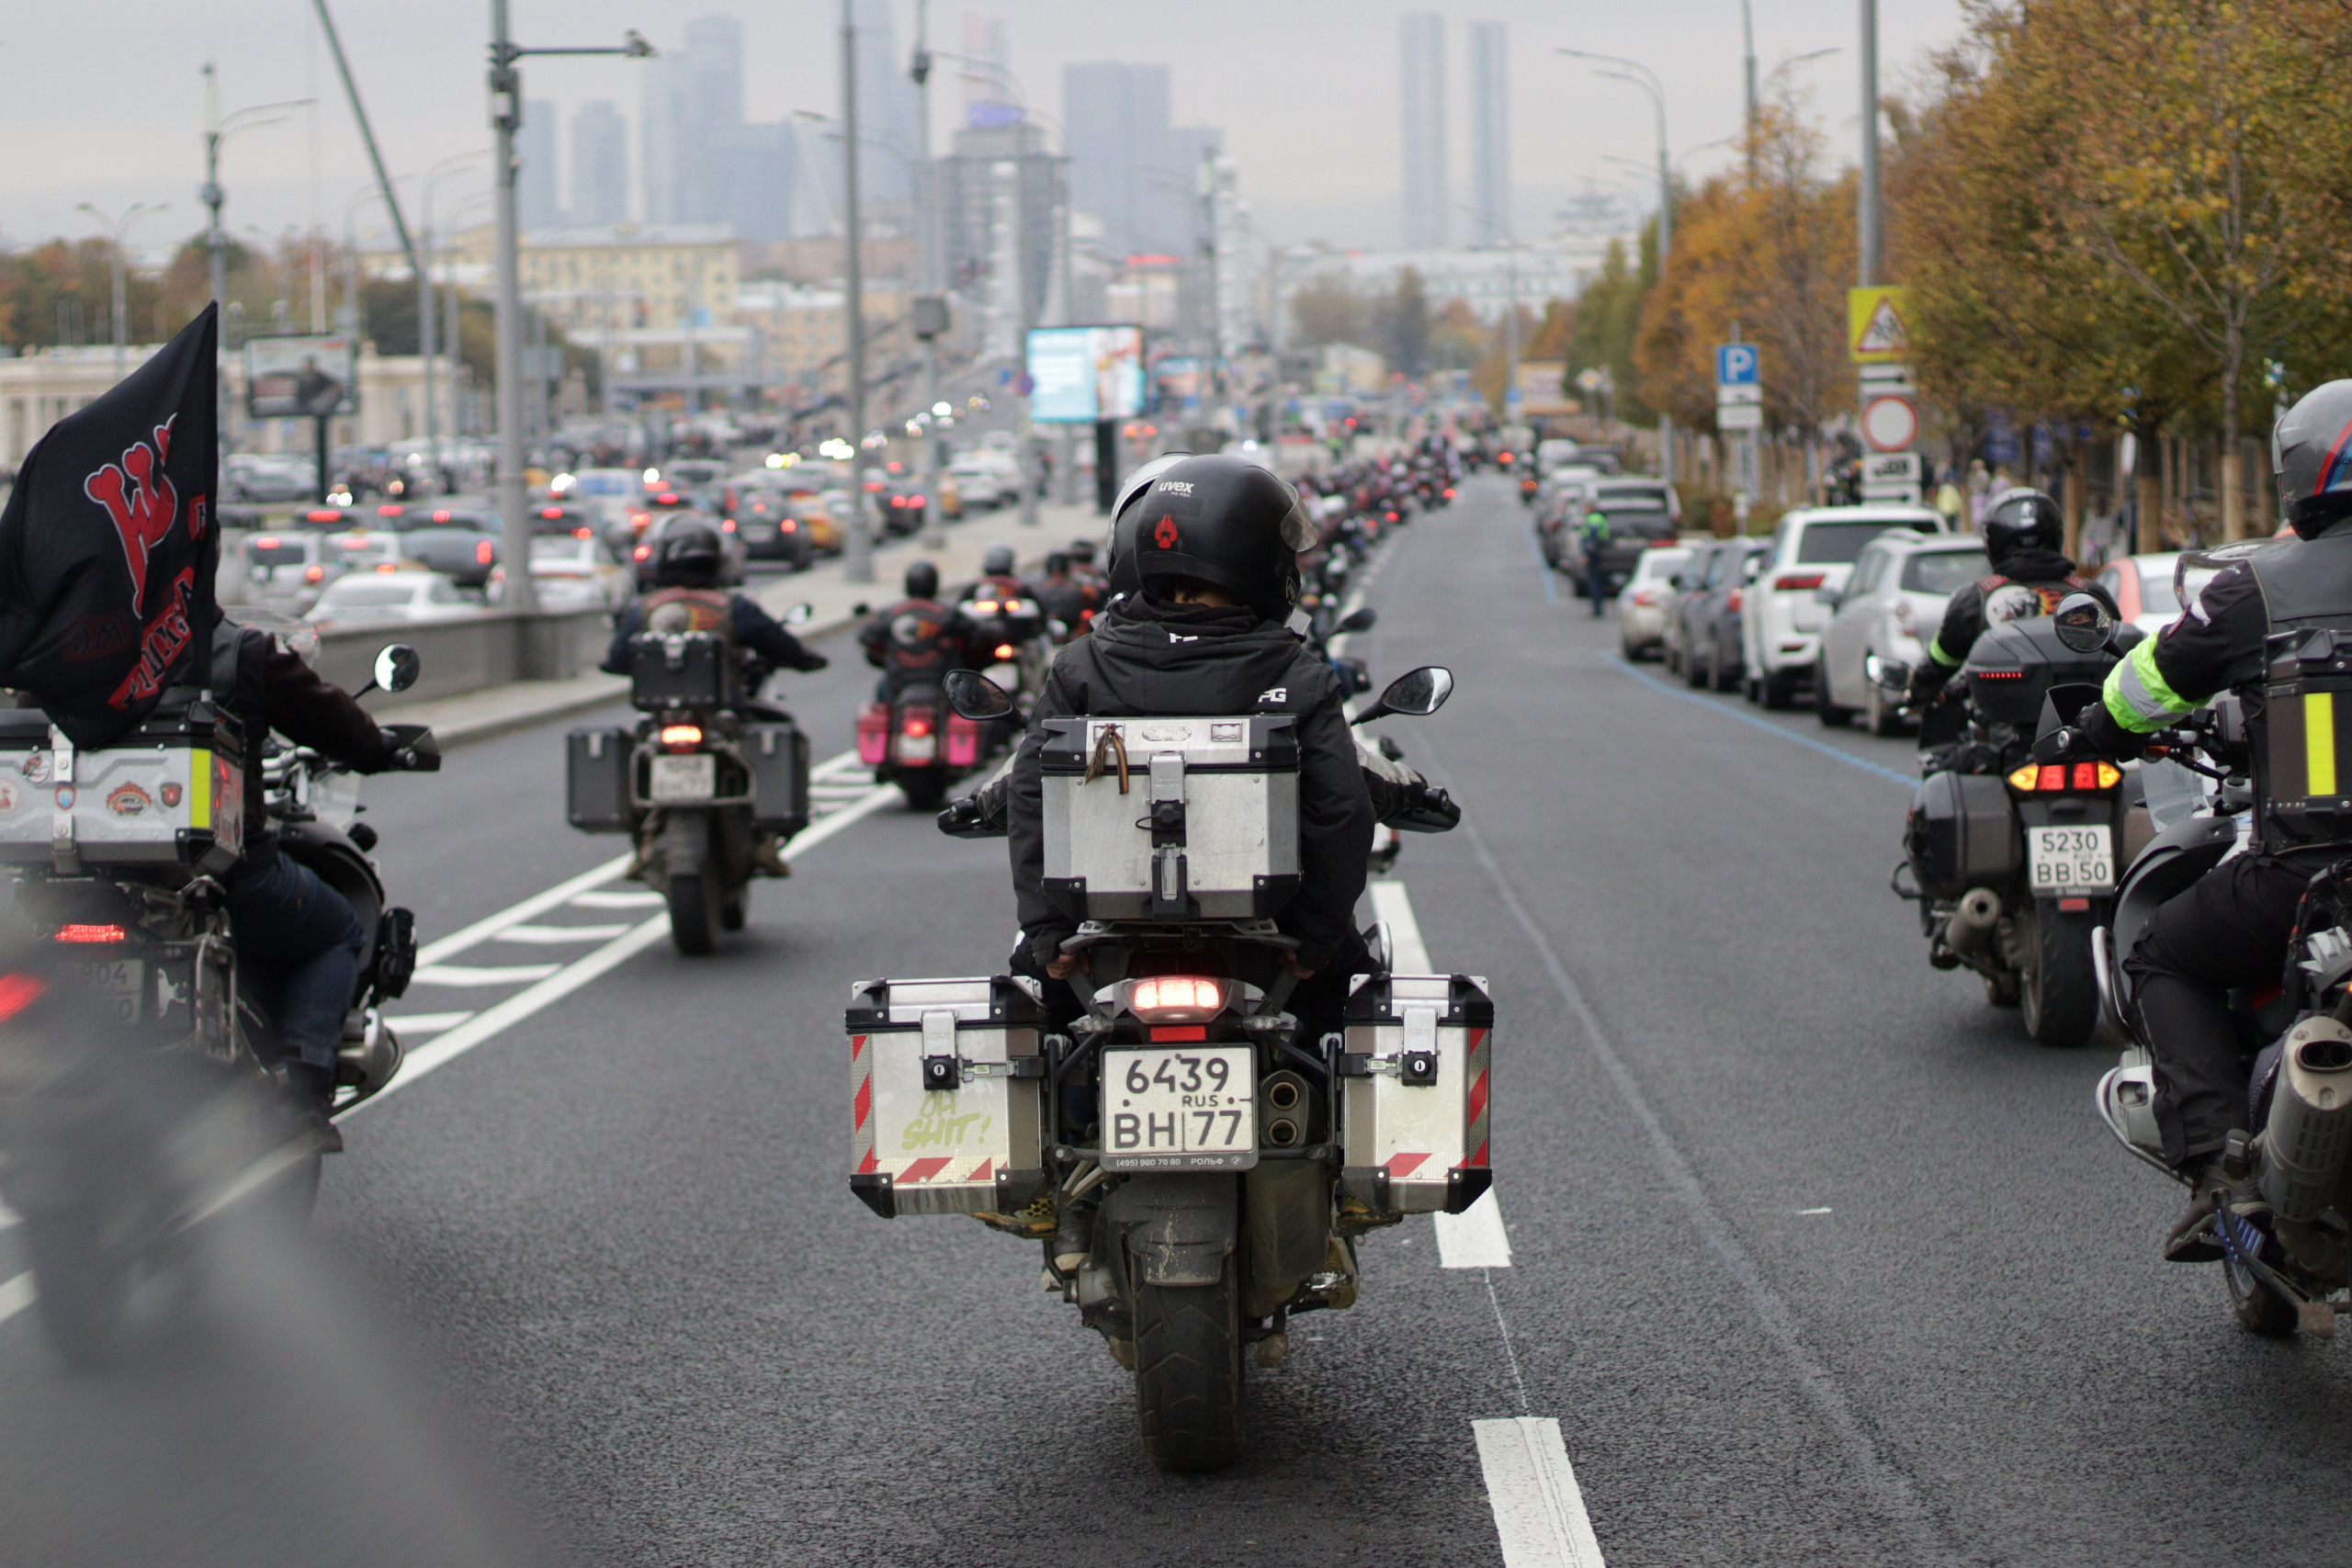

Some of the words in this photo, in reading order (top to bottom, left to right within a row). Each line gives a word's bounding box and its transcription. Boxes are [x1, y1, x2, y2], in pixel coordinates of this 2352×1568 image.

[1726, 348, 1753, 381] P
[1159, 481, 1195, 494] uvex
[2042, 831, 2098, 852] 5230
[2080, 862, 2107, 882] 50
[1125, 1057, 1229, 1094] 6439
[920, 1090, 956, 1119] OH
[1182, 1095, 1219, 1107] RUS
[1193, 1110, 1242, 1146] 77
[1116, 1158, 1138, 1168] (495)
[1140, 1158, 1156, 1167] 980
[1191, 1157, 1224, 1166] РОЛЬФ
